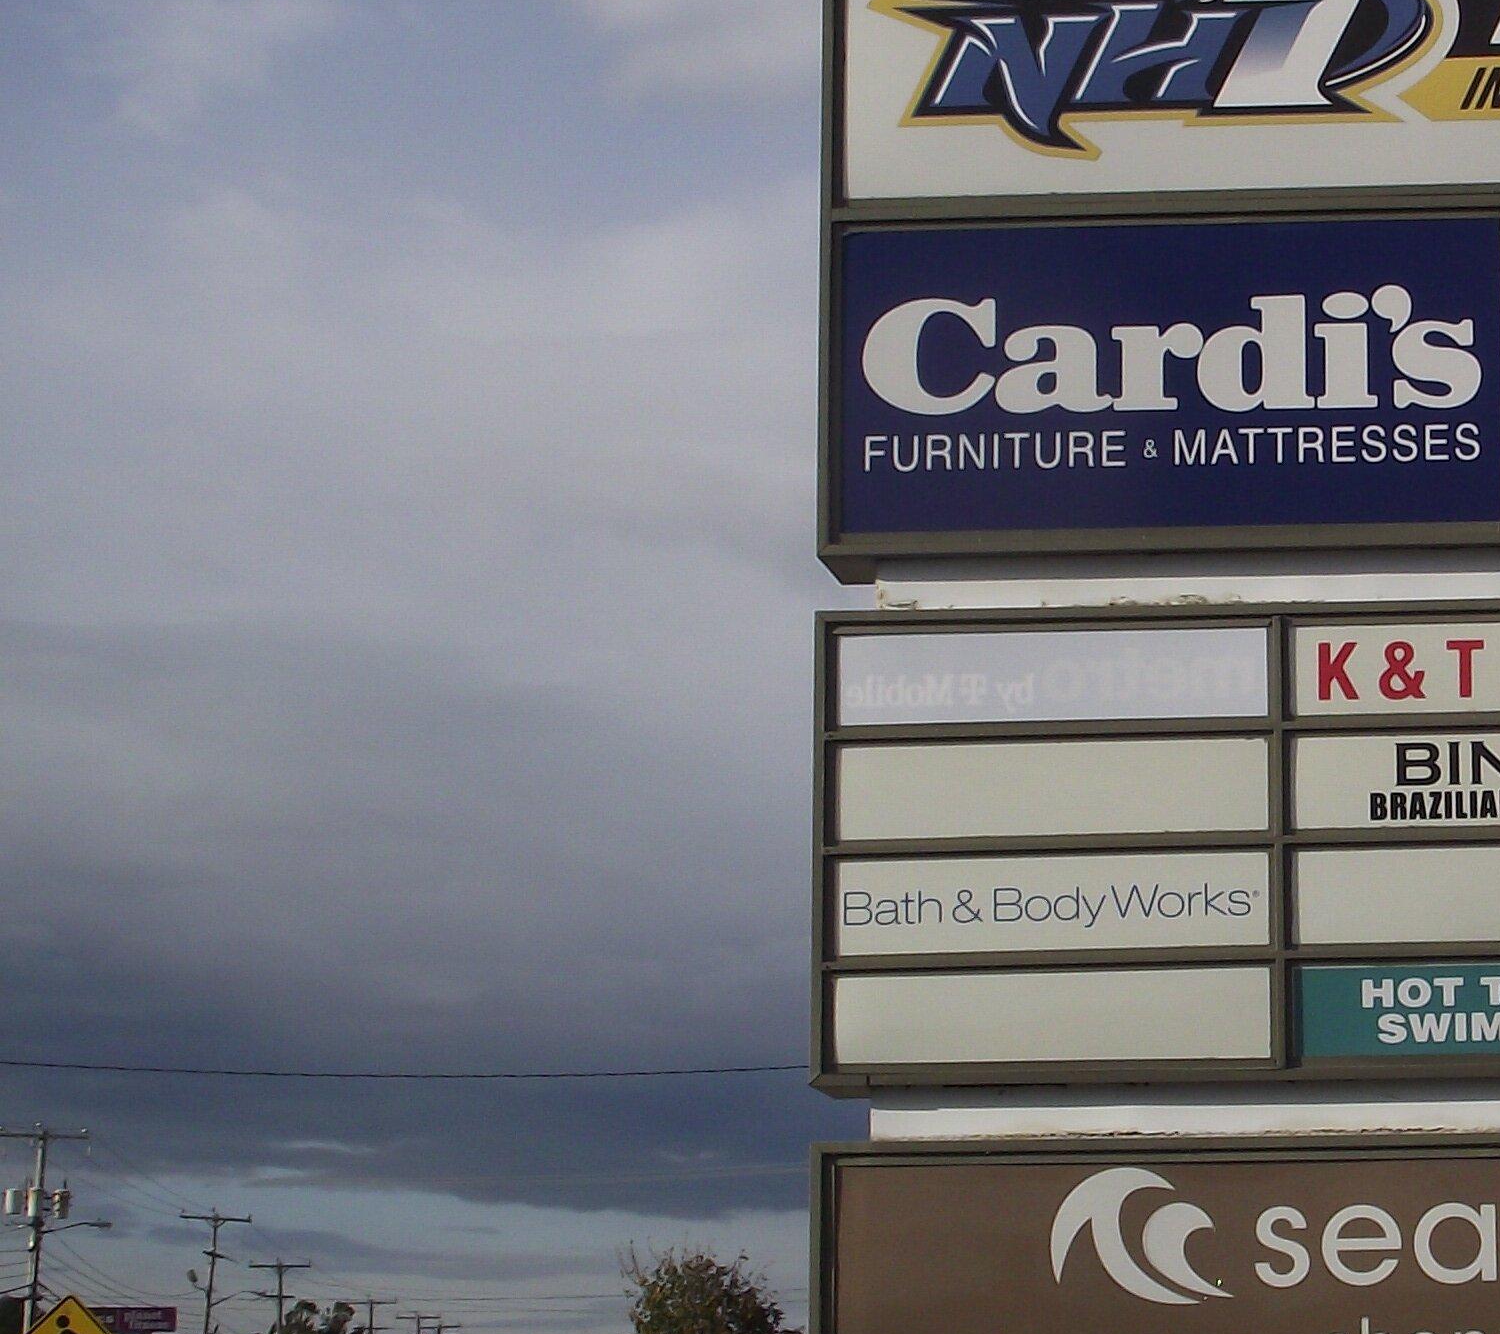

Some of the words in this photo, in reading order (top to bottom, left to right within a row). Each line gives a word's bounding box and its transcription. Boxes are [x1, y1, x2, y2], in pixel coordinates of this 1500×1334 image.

[862, 285, 1481, 415] Cardi's
[865, 431, 1125, 471] FURNITURE
[1144, 440, 1157, 458] &
[1175, 423, 1479, 464] MATTRESSES
[1319, 642, 1359, 700] K
[1379, 641, 1425, 700] &
[1447, 640, 1484, 697] T
[844, 890, 942, 927] Bath
[952, 890, 983, 923] &
[994, 887, 1106, 927] Body
[1362, 977, 1463, 1007] HOT
